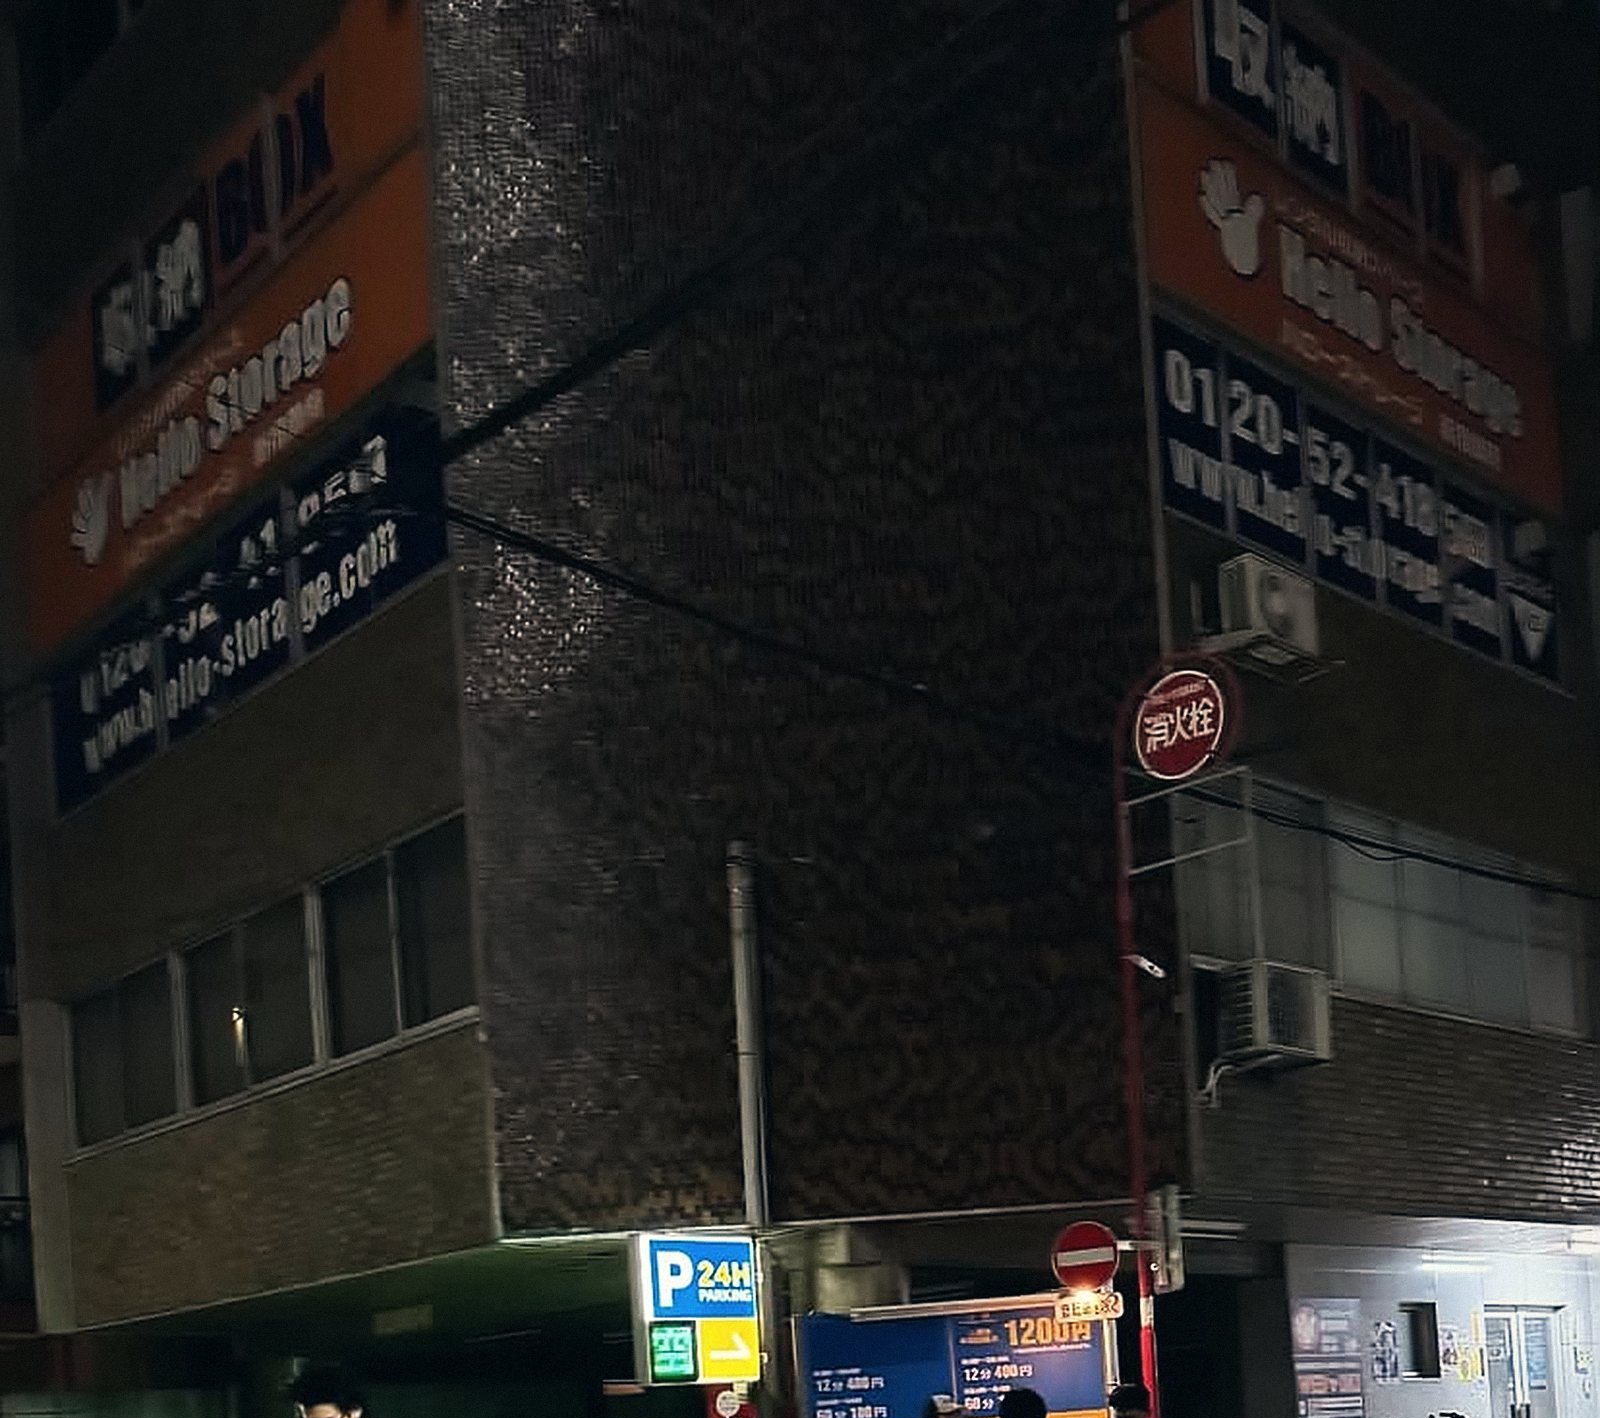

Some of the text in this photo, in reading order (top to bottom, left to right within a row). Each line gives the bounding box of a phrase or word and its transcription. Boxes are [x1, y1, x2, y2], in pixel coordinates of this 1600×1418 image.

[1143, 697, 1216, 753] 消火栓
[656, 1250, 751, 1308] P 24H
[698, 1287, 753, 1303] PARKING
